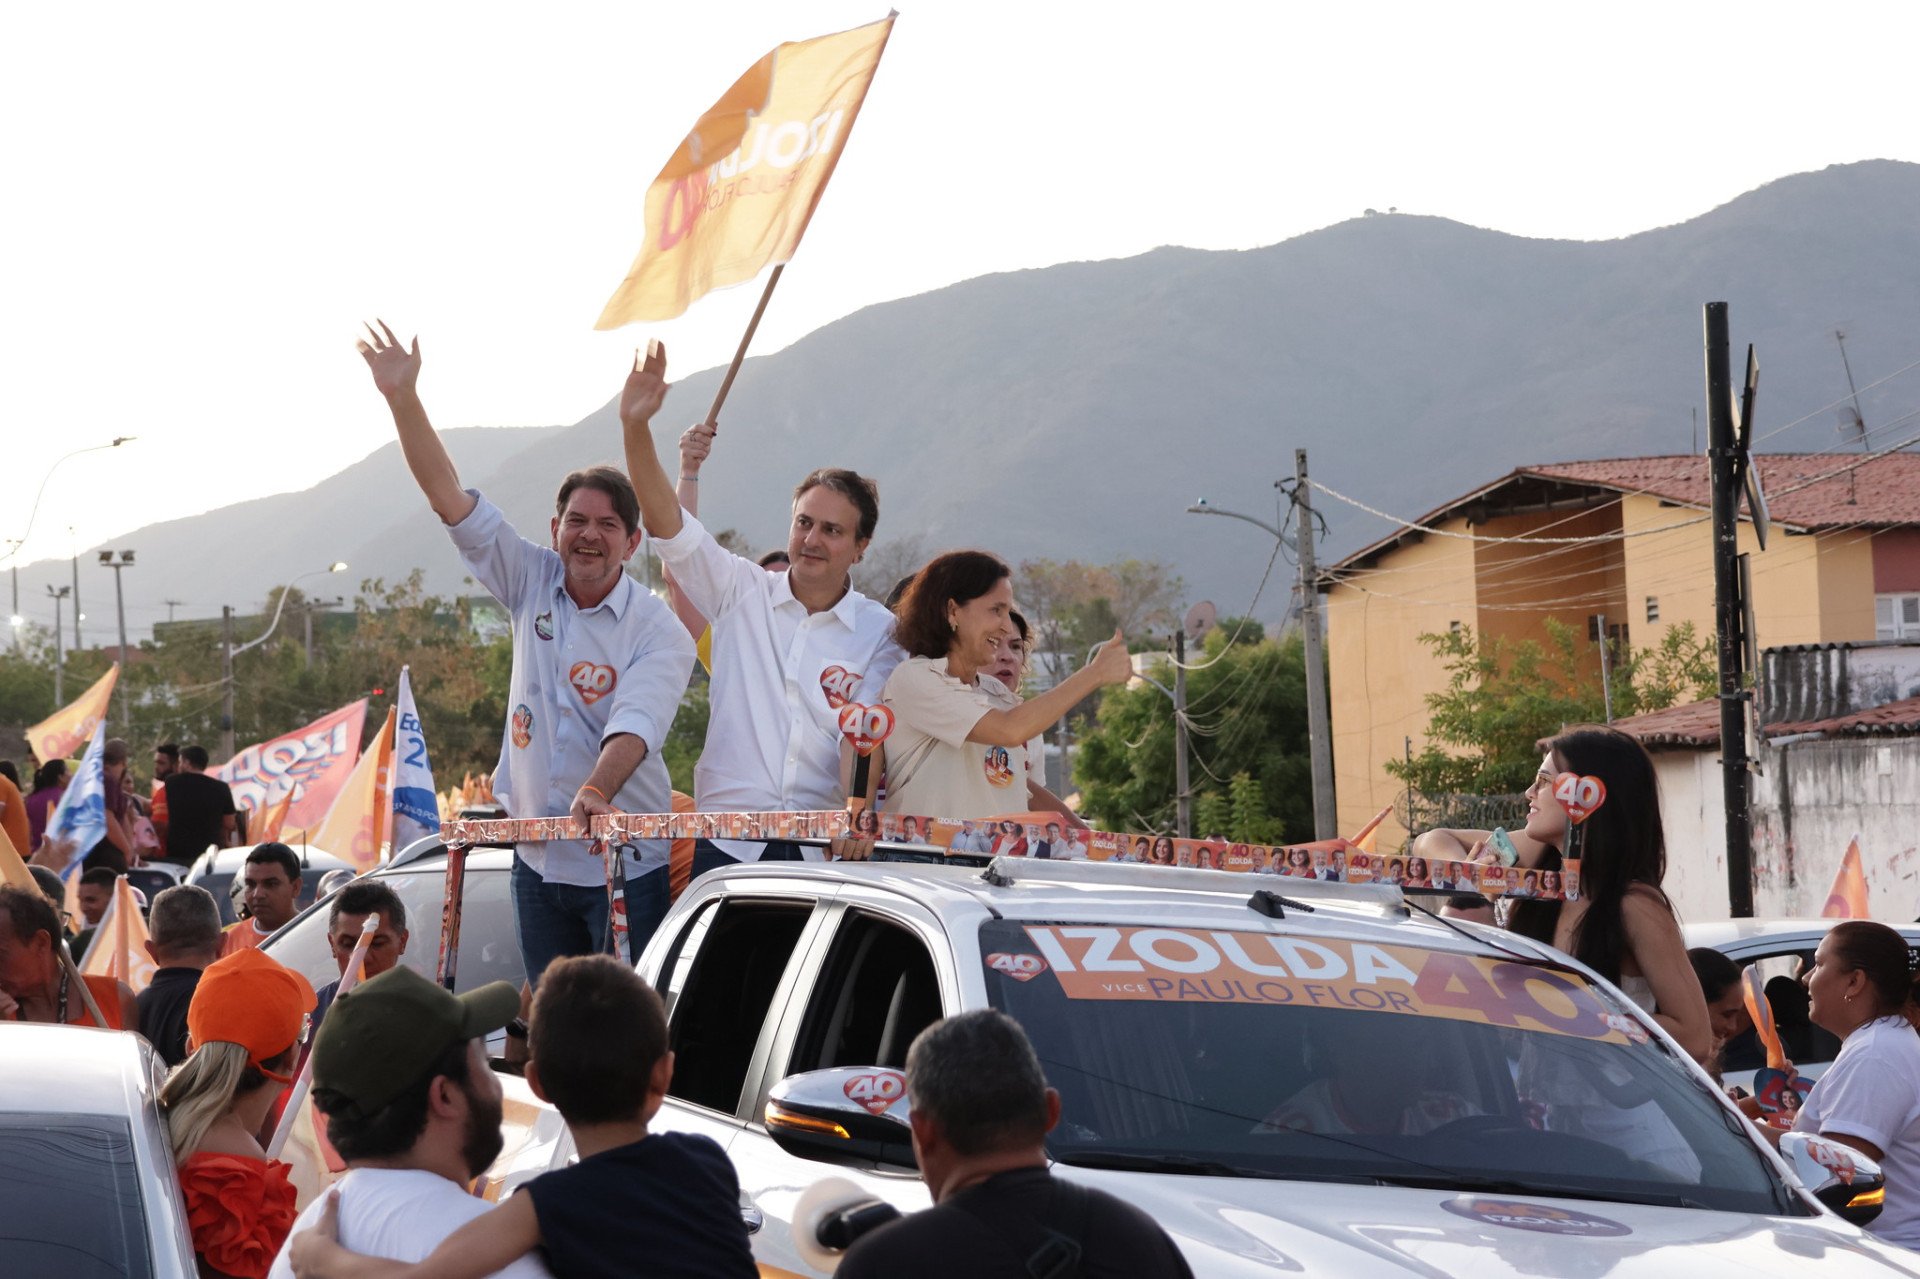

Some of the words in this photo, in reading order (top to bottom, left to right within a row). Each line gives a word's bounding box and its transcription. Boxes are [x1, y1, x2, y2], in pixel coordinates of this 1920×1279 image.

[573, 665, 613, 692] 40
[842, 708, 889, 739] 40
[1555, 777, 1600, 809] 40
[1091, 840, 1117, 850] IZOLDA
[1231, 844, 1250, 857] 40
[1227, 857, 1253, 866] IZOLDA
[1351, 855, 1370, 868] 40
[1348, 867, 1372, 876] IZOLDA
[1484, 867, 1504, 879] 40
[1482, 879, 1507, 887] IZOLDA
[992, 953, 1043, 973] 40
[1027, 927, 1418, 985] IZOLDA
[1413, 952, 1611, 1038] 40
[1101, 982, 1148, 994] VICE
[1146, 977, 1295, 1003] PAULO
[1302, 984, 1419, 1013] FLOR
[850, 1076, 903, 1100] 40
